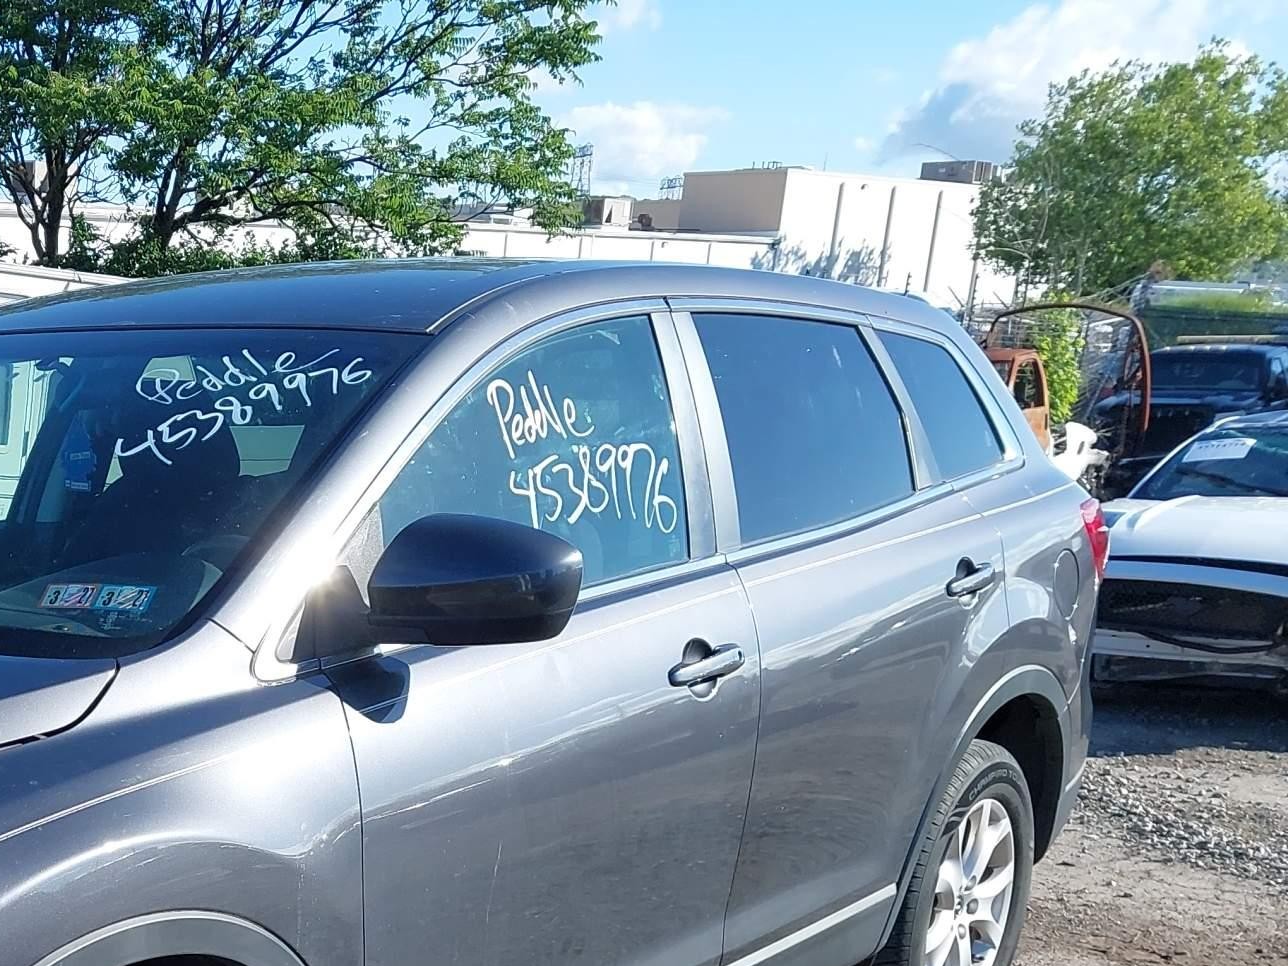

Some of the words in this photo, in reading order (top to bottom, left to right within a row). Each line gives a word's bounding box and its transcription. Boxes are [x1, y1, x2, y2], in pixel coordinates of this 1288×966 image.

[114, 358, 372, 465] 45389976
[487, 369, 594, 459] Peddle
[510, 443, 677, 533] 45389976
